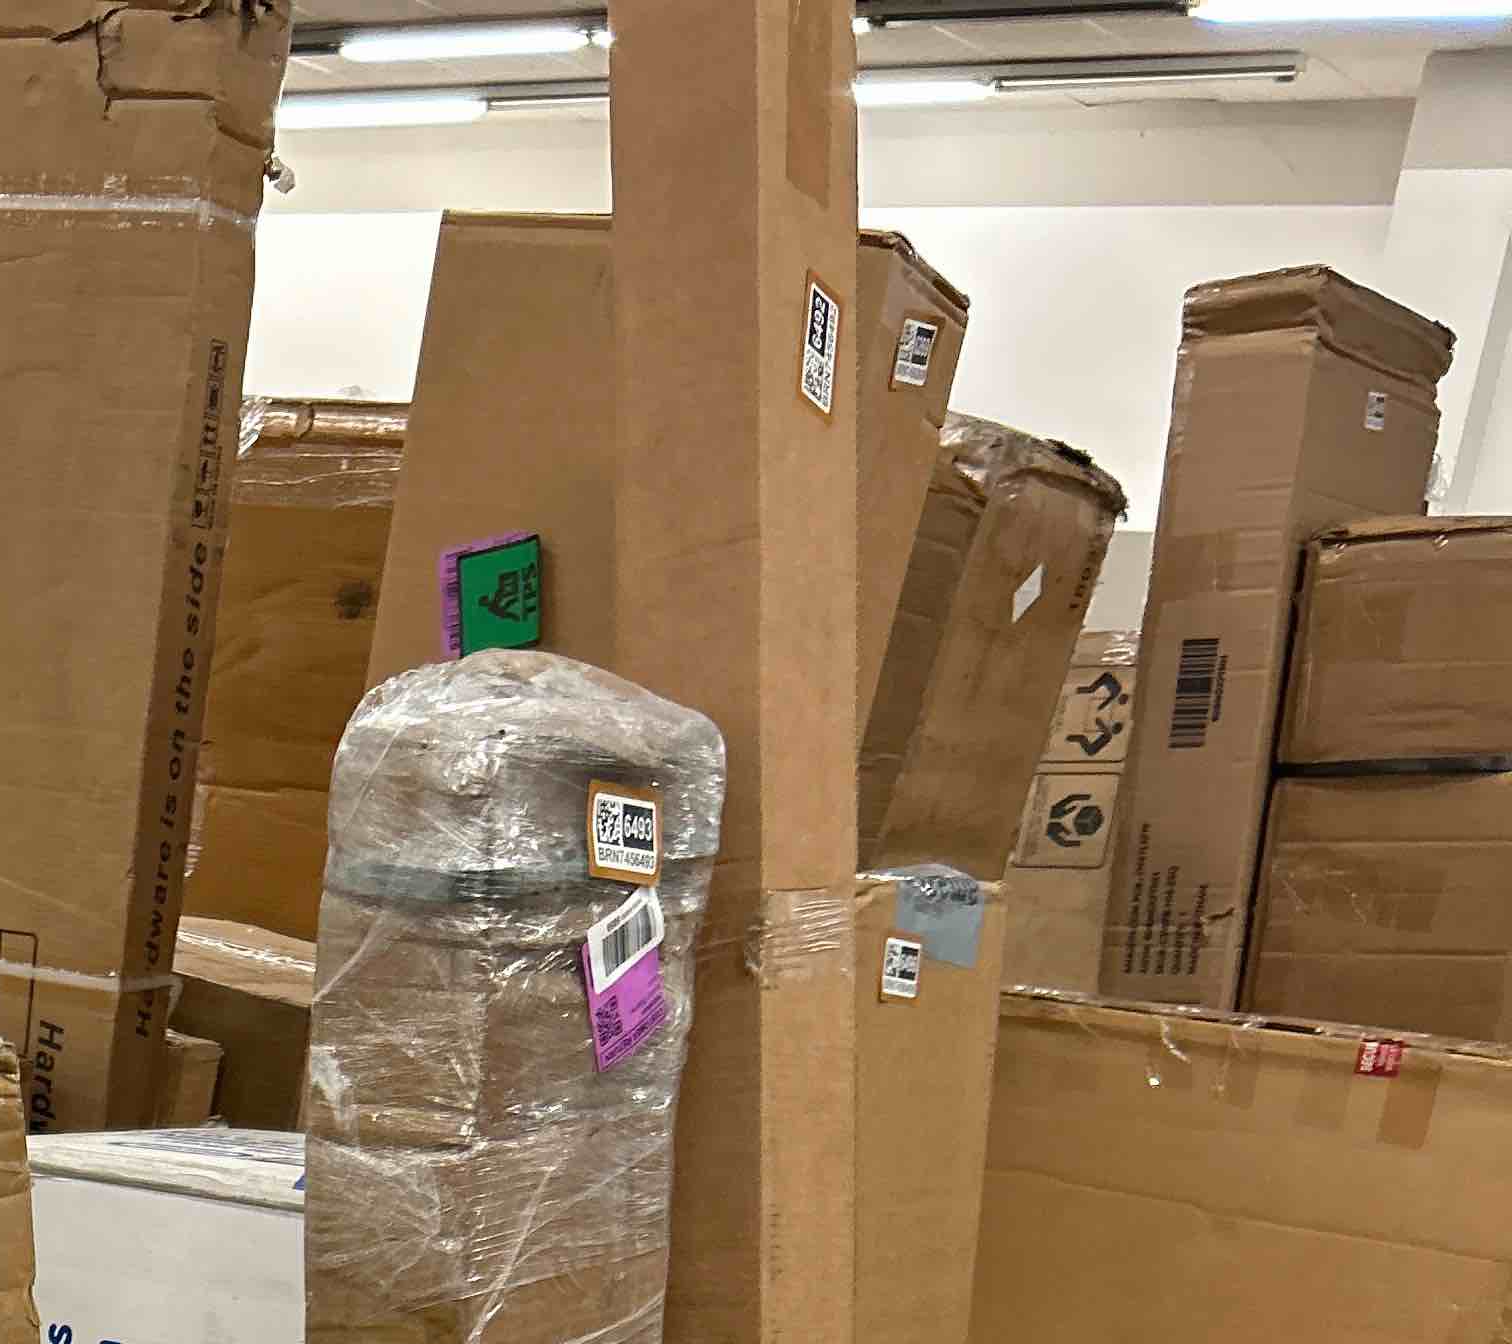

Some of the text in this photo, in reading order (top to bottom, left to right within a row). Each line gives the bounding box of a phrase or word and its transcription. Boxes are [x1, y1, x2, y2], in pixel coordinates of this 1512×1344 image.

[812, 296, 826, 350] 6492
[135, 542, 208, 1038] Hadware is on the side
[624, 814, 653, 841] 6493
